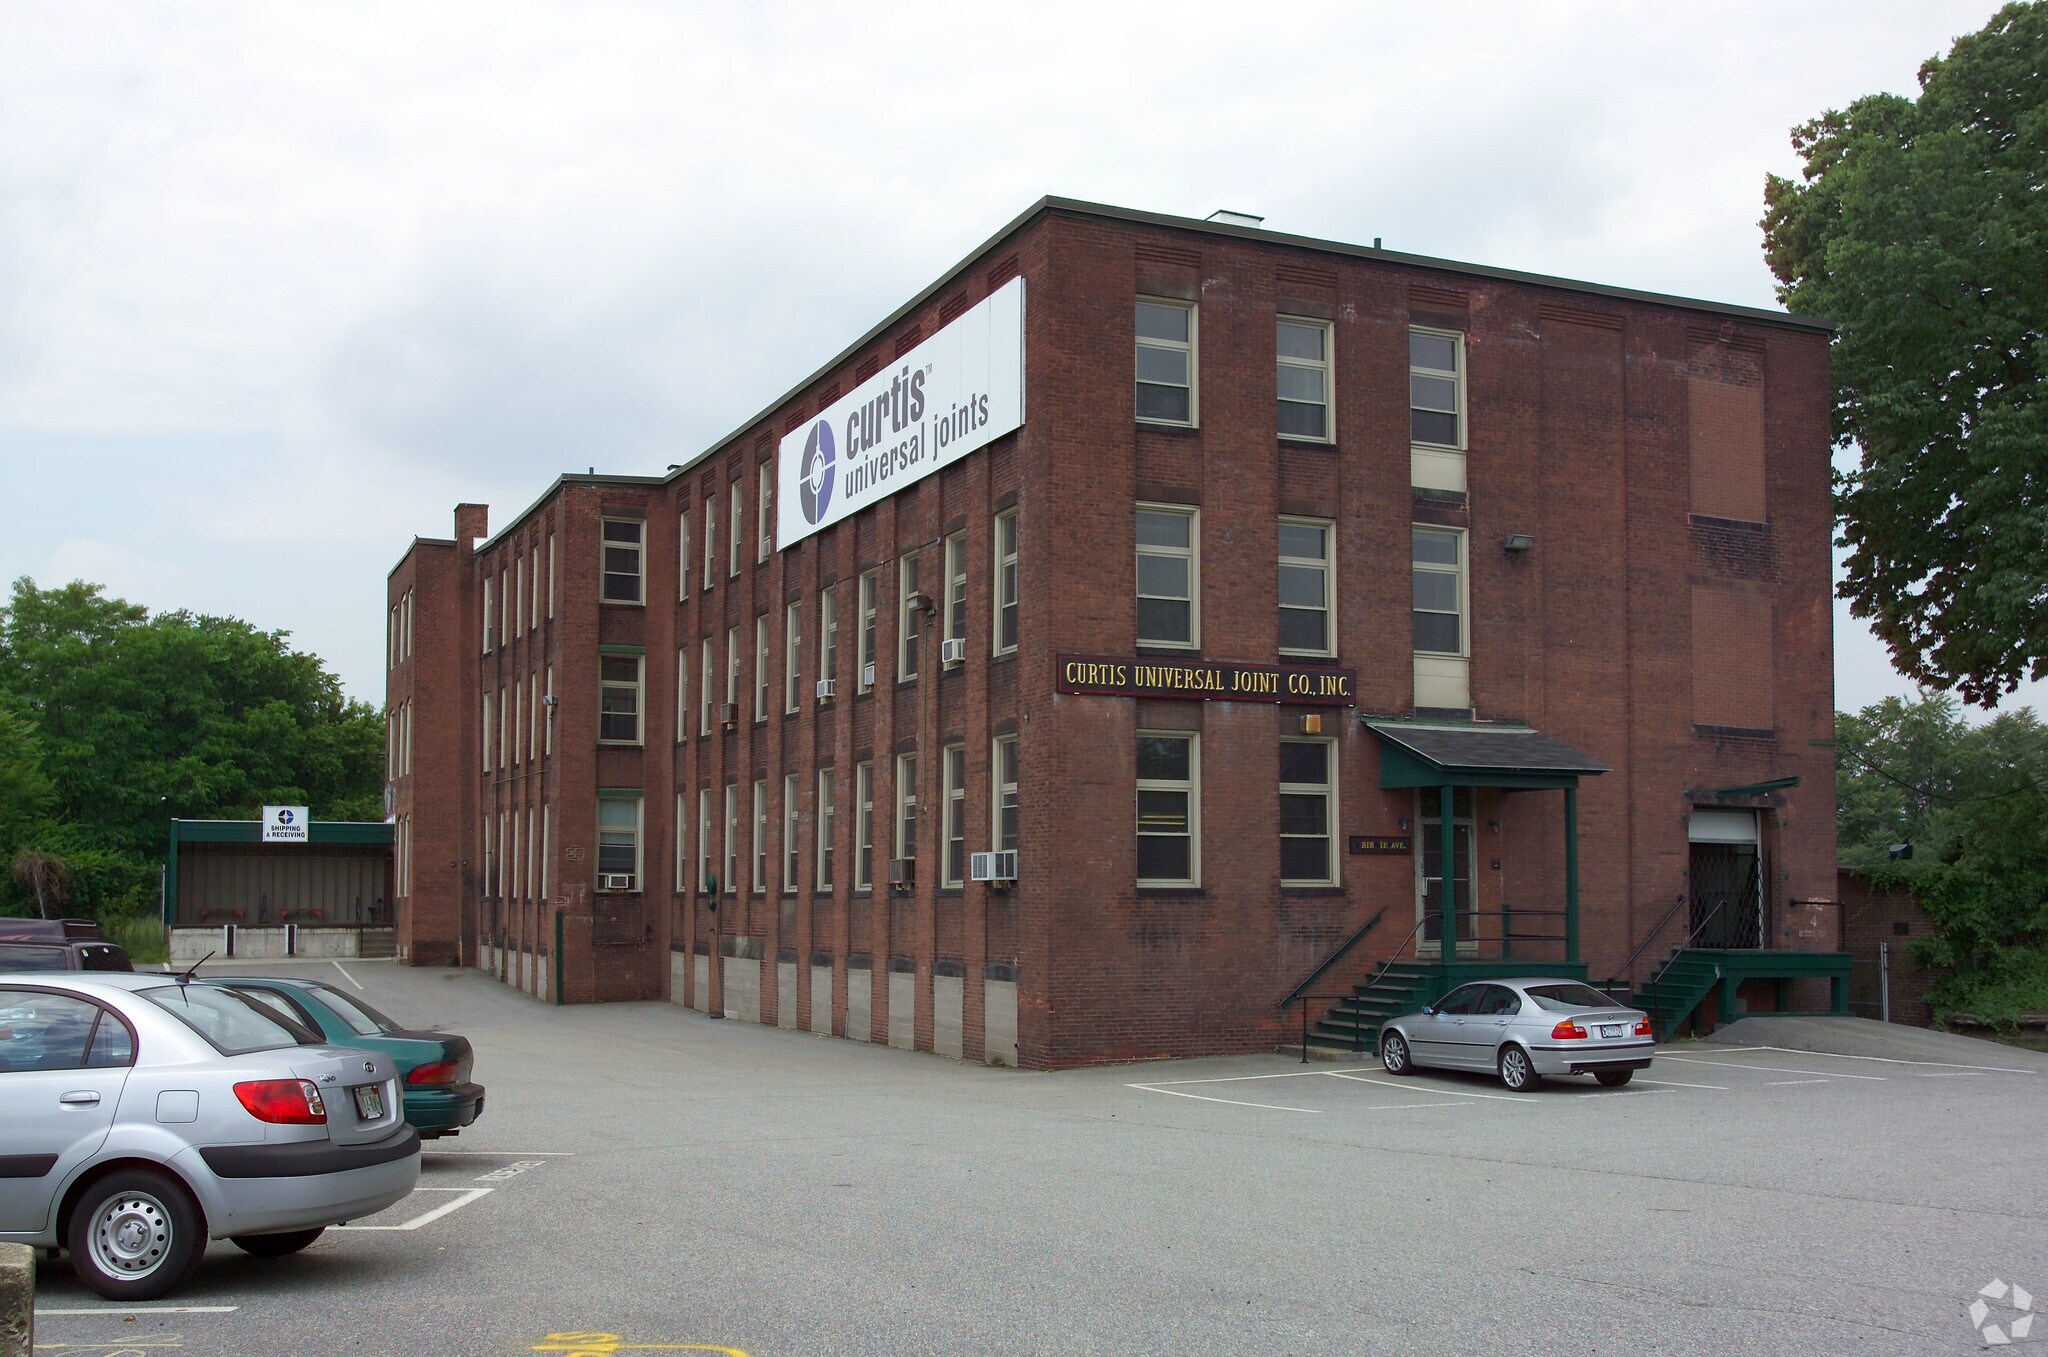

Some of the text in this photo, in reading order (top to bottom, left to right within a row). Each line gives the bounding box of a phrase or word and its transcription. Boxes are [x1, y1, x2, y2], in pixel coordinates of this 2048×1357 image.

[845, 393, 988, 499] universal joints
[846, 365, 925, 460] curtis
[1066, 662, 1126, 686] CURTIS
[1134, 666, 1224, 691] UNIVERSAL
[1231, 671, 1280, 693] JOINT
[1320, 676, 1351, 697] INC.
